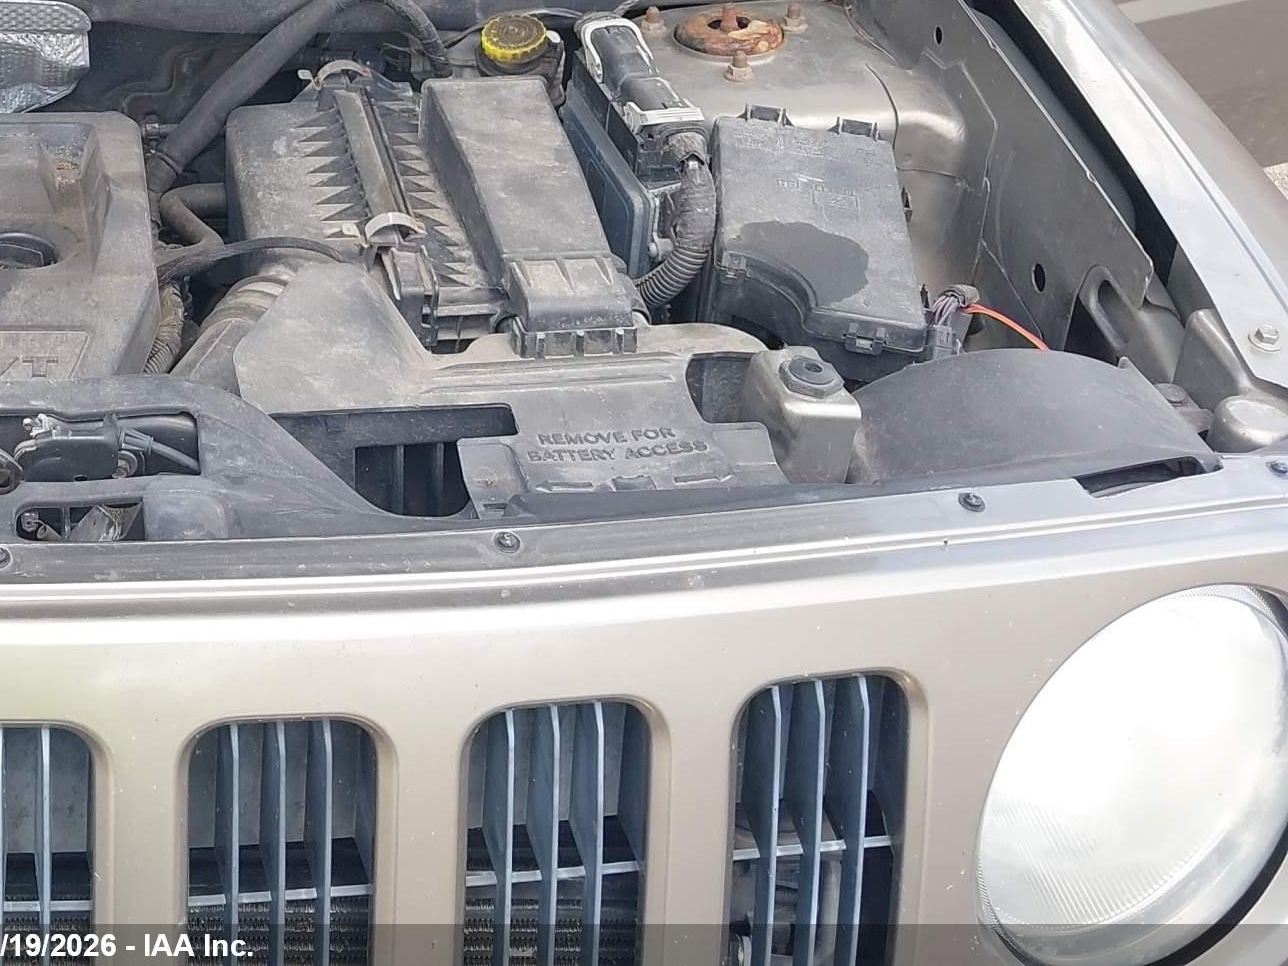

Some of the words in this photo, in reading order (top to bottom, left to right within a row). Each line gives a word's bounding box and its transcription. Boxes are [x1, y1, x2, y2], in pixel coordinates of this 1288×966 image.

[537, 431, 628, 446] REMOVE
[631, 426, 677, 442] FOR
[526, 447, 616, 463] BATTERY
[624, 441, 709, 460] ACCESS
